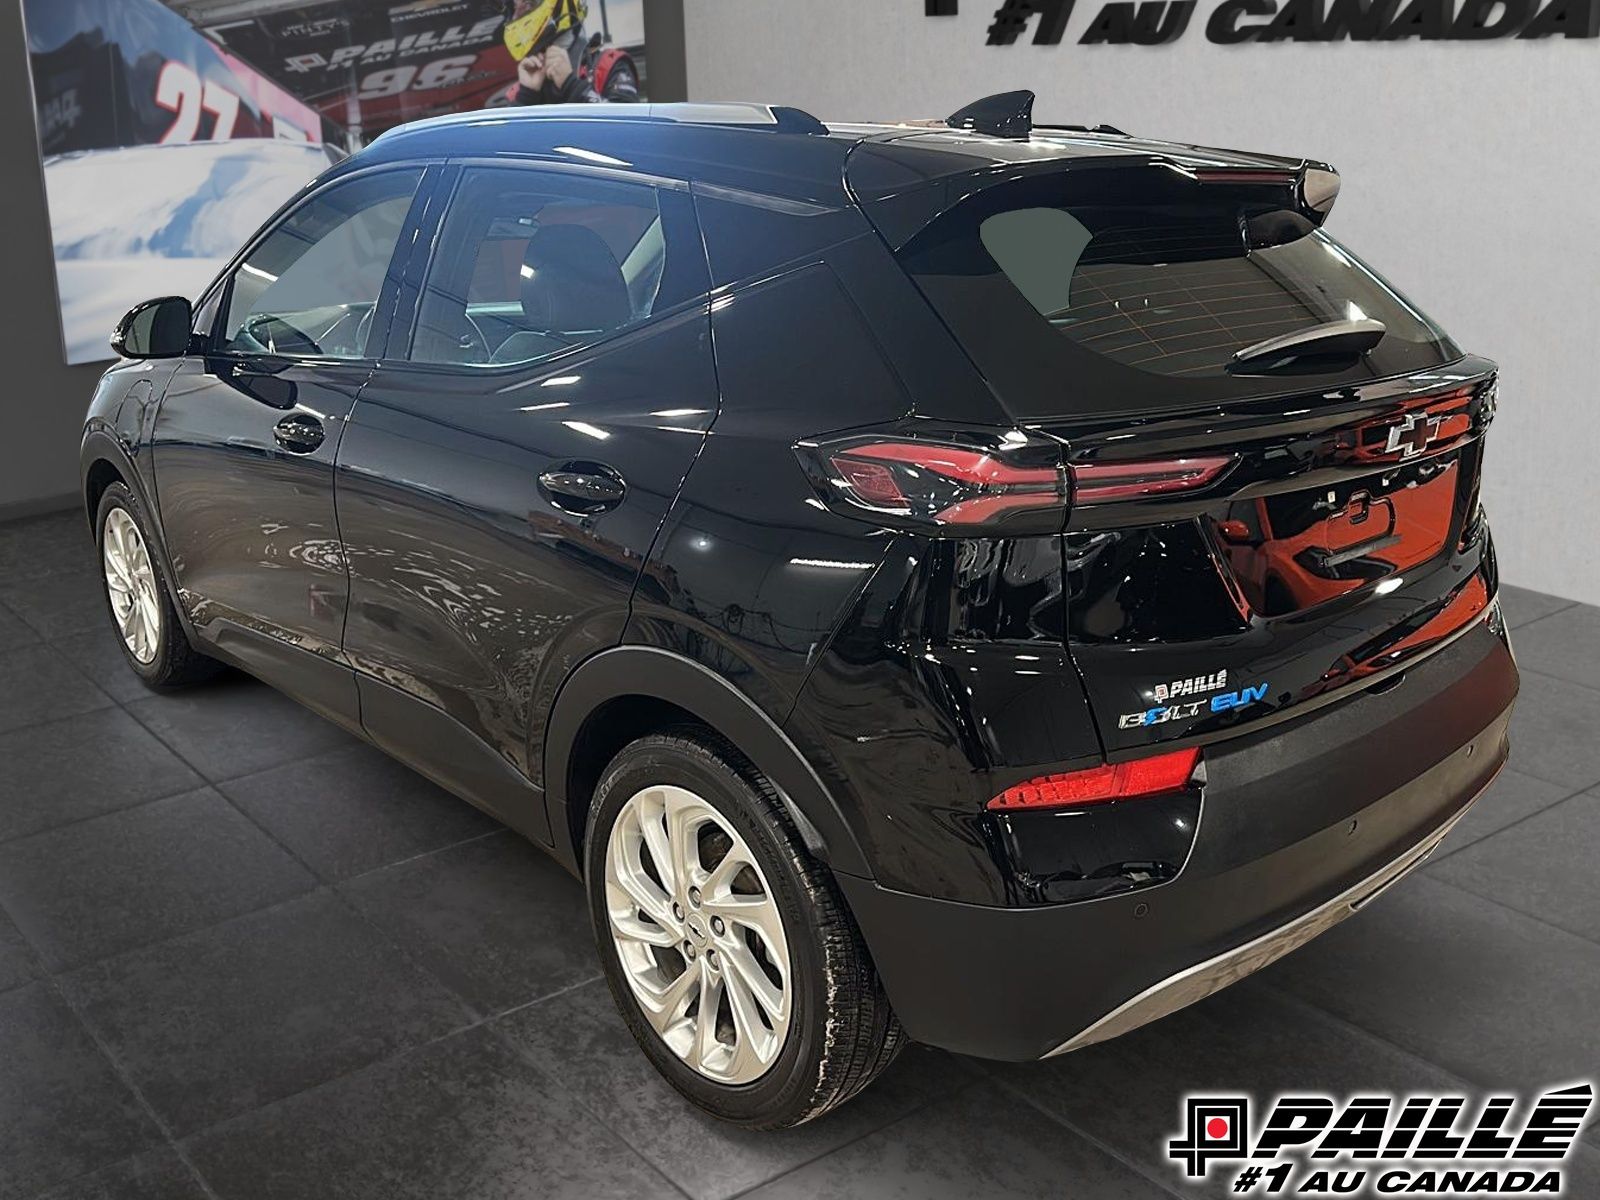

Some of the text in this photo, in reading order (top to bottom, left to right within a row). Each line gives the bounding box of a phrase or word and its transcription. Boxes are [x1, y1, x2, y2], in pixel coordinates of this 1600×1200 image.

[985, 0, 1599, 45] #1 AU CANADA
[399, 35, 493, 56] CANADA
[358, 54, 476, 99] 96
[157, 59, 240, 144] 27
[1119, 682, 1269, 729] BOLT EUV
